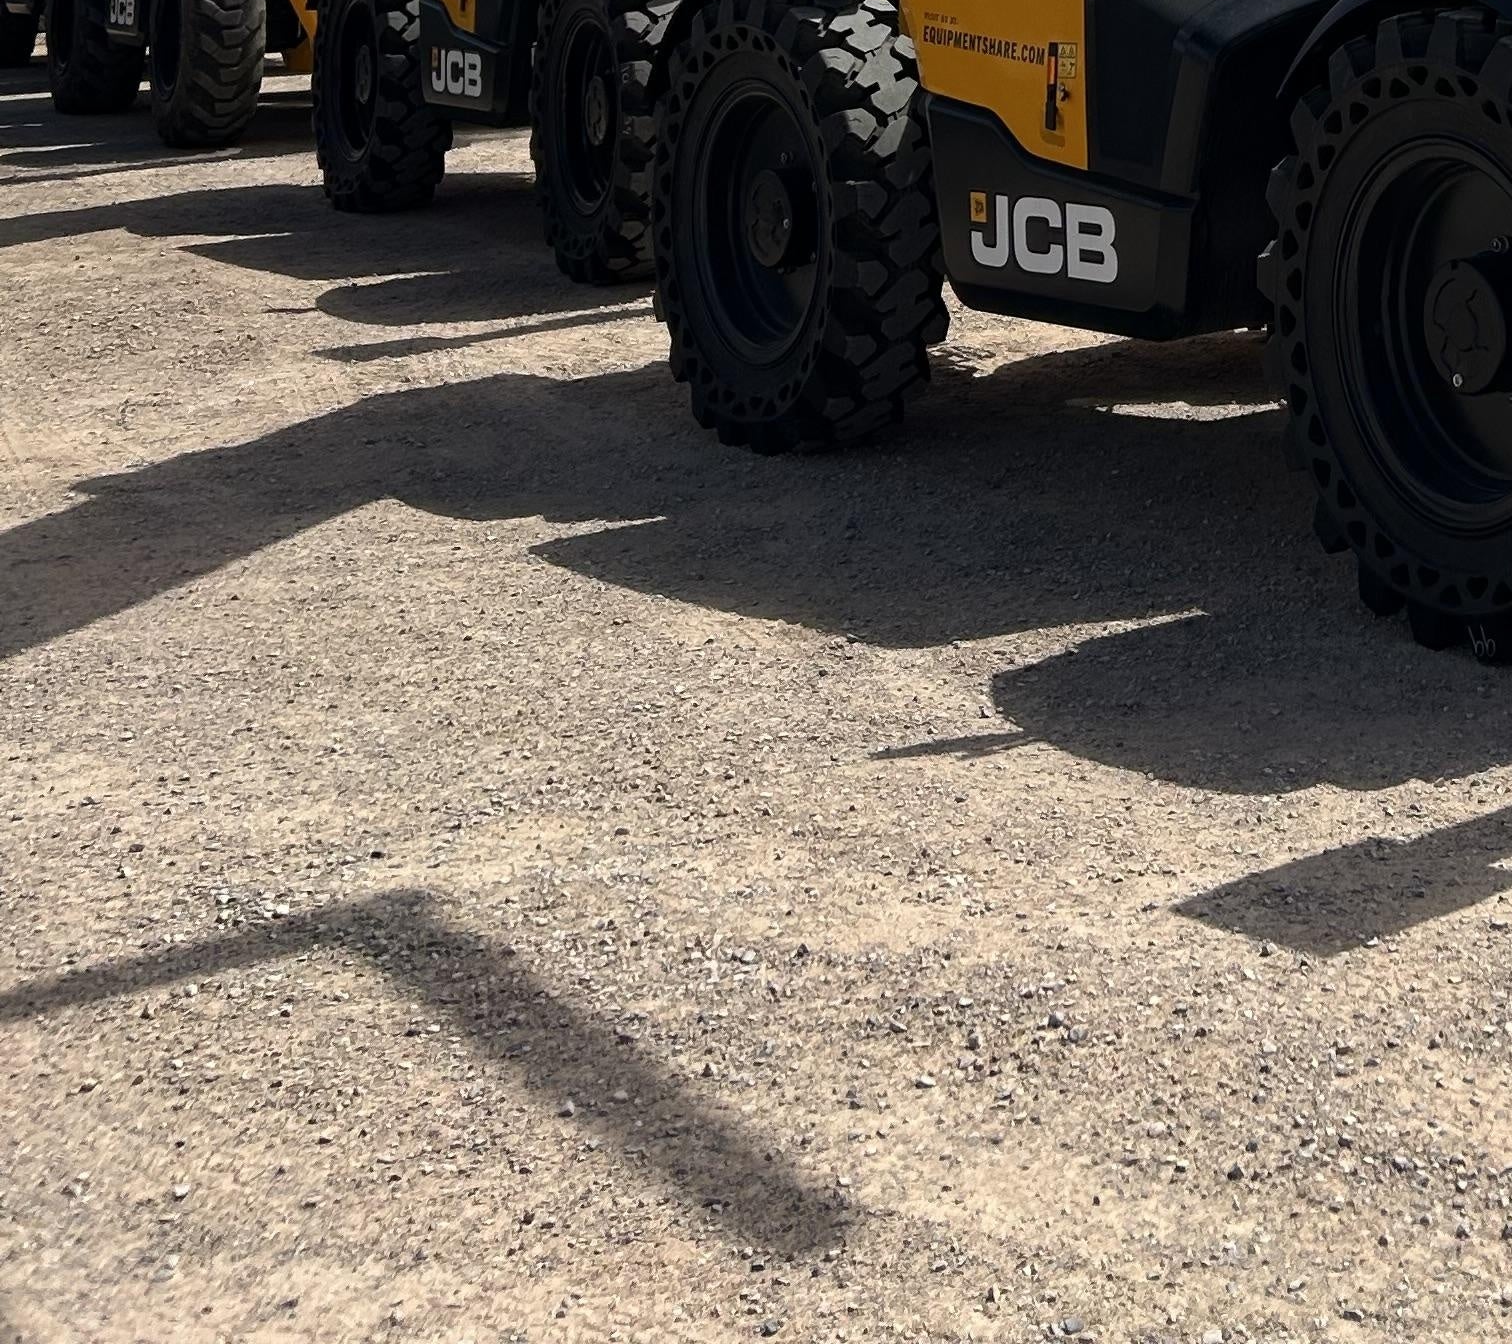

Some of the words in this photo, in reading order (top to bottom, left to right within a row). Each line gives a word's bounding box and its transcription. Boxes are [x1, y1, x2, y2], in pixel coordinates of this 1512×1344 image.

[923, 25, 1046, 66] EQUIPMENTSHARE.COM
[431, 47, 482, 98] JCB
[970, 193, 1119, 284] JCB
